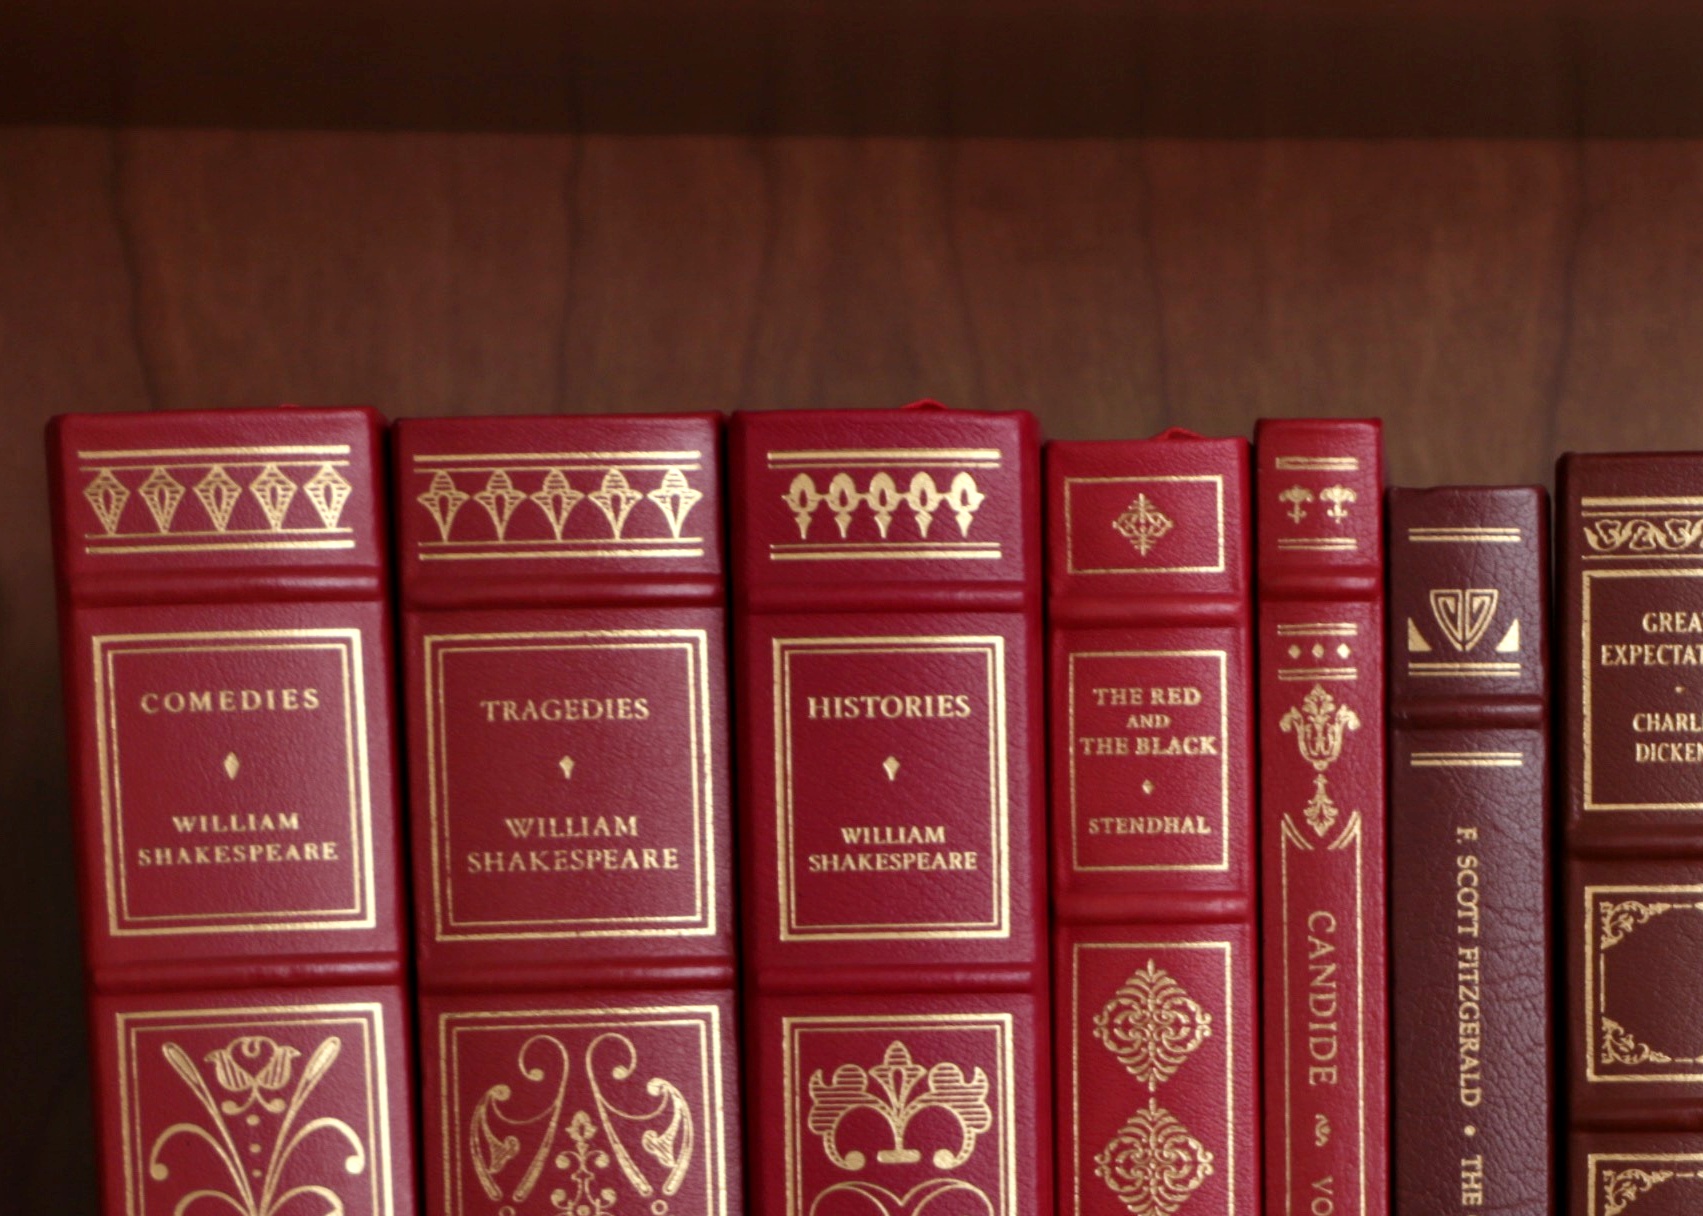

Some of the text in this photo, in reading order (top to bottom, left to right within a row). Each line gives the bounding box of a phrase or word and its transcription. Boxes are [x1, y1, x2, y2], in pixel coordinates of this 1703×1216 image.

[140, 687, 321, 716] COMEDIES
[807, 695, 972, 719] HISTORIES
[1093, 687, 1202, 707] THE RED
[480, 697, 650, 723] TRAGEDIES
[1126, 714, 1171, 729] AND
[1080, 737, 1218, 756] THE BLACK
[172, 812, 301, 834] WILLIAM
[505, 815, 639, 839] WILLIAM
[1088, 816, 1212, 835] STENDHAL
[840, 826, 946, 845] WILLIAM
[1456, 826, 1479, 846] F.
[137, 841, 340, 868] SHAKESPEARE
[467, 847, 681, 875] SHAKESPEARE
[808, 851, 979, 872] SHAKESPEARE
[1456, 854, 1479, 938] SCOTT
[1308, 909, 1338, 1087] CANDIDE
[1458, 945, 1482, 1108] FITZGERALD
[1461, 1154, 1483, 1206] THE
